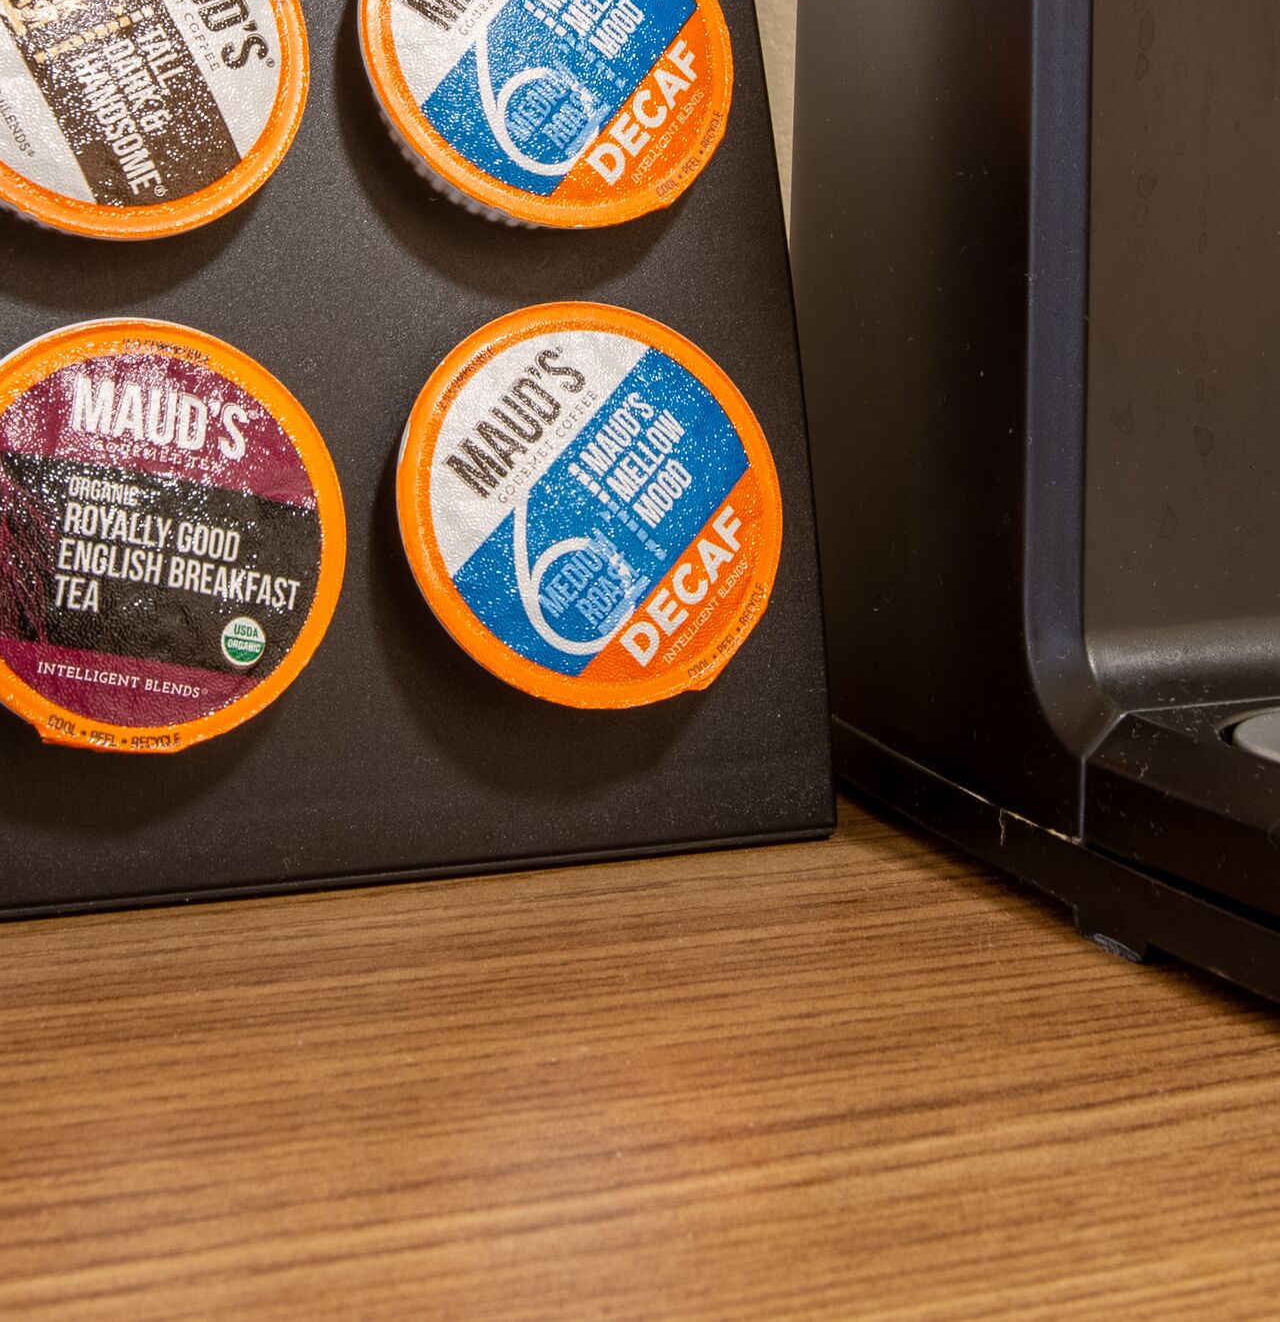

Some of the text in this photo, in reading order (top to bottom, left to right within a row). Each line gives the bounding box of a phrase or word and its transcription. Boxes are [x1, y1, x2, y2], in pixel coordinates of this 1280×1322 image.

[103, 37, 164, 111] DARK
[70, 49, 164, 197] HANDSOME
[587, 38, 698, 187] DECAF
[631, 90, 705, 185] INTELLIGENT BLENDS
[700, 109, 724, 149] RECYCLE
[72, 373, 250, 461] MAUD'S
[442, 349, 586, 499] MAUD'S
[555, 390, 599, 438] COFFEE
[579, 391, 655, 477] MAUD'S
[69, 476, 139, 506] ORGANIC
[94, 439, 222, 473] GOURMET TEA
[606, 408, 686, 503] MELLOW
[632, 458, 693, 529] MOOD
[64, 501, 241, 564] ROYALLY GOOD
[55, 574, 102, 614] TEA
[58, 537, 301, 612] ENGLISH BREAKFAST
[538, 527, 619, 619] MEDIUM
[576, 550, 640, 627] ROAST
[620, 504, 742, 668] DECAF
[738, 581, 766, 626] RECYCLE
[226, 638, 262, 654] ORGANIC
[233, 623, 259, 639] USDA
[662, 558, 750, 664] INTELLIGENT BLENDS
[36, 661, 201, 699] INTELLIGENT BLENDS
[47, 714, 182, 750] COOL PEEL RECYCLE
